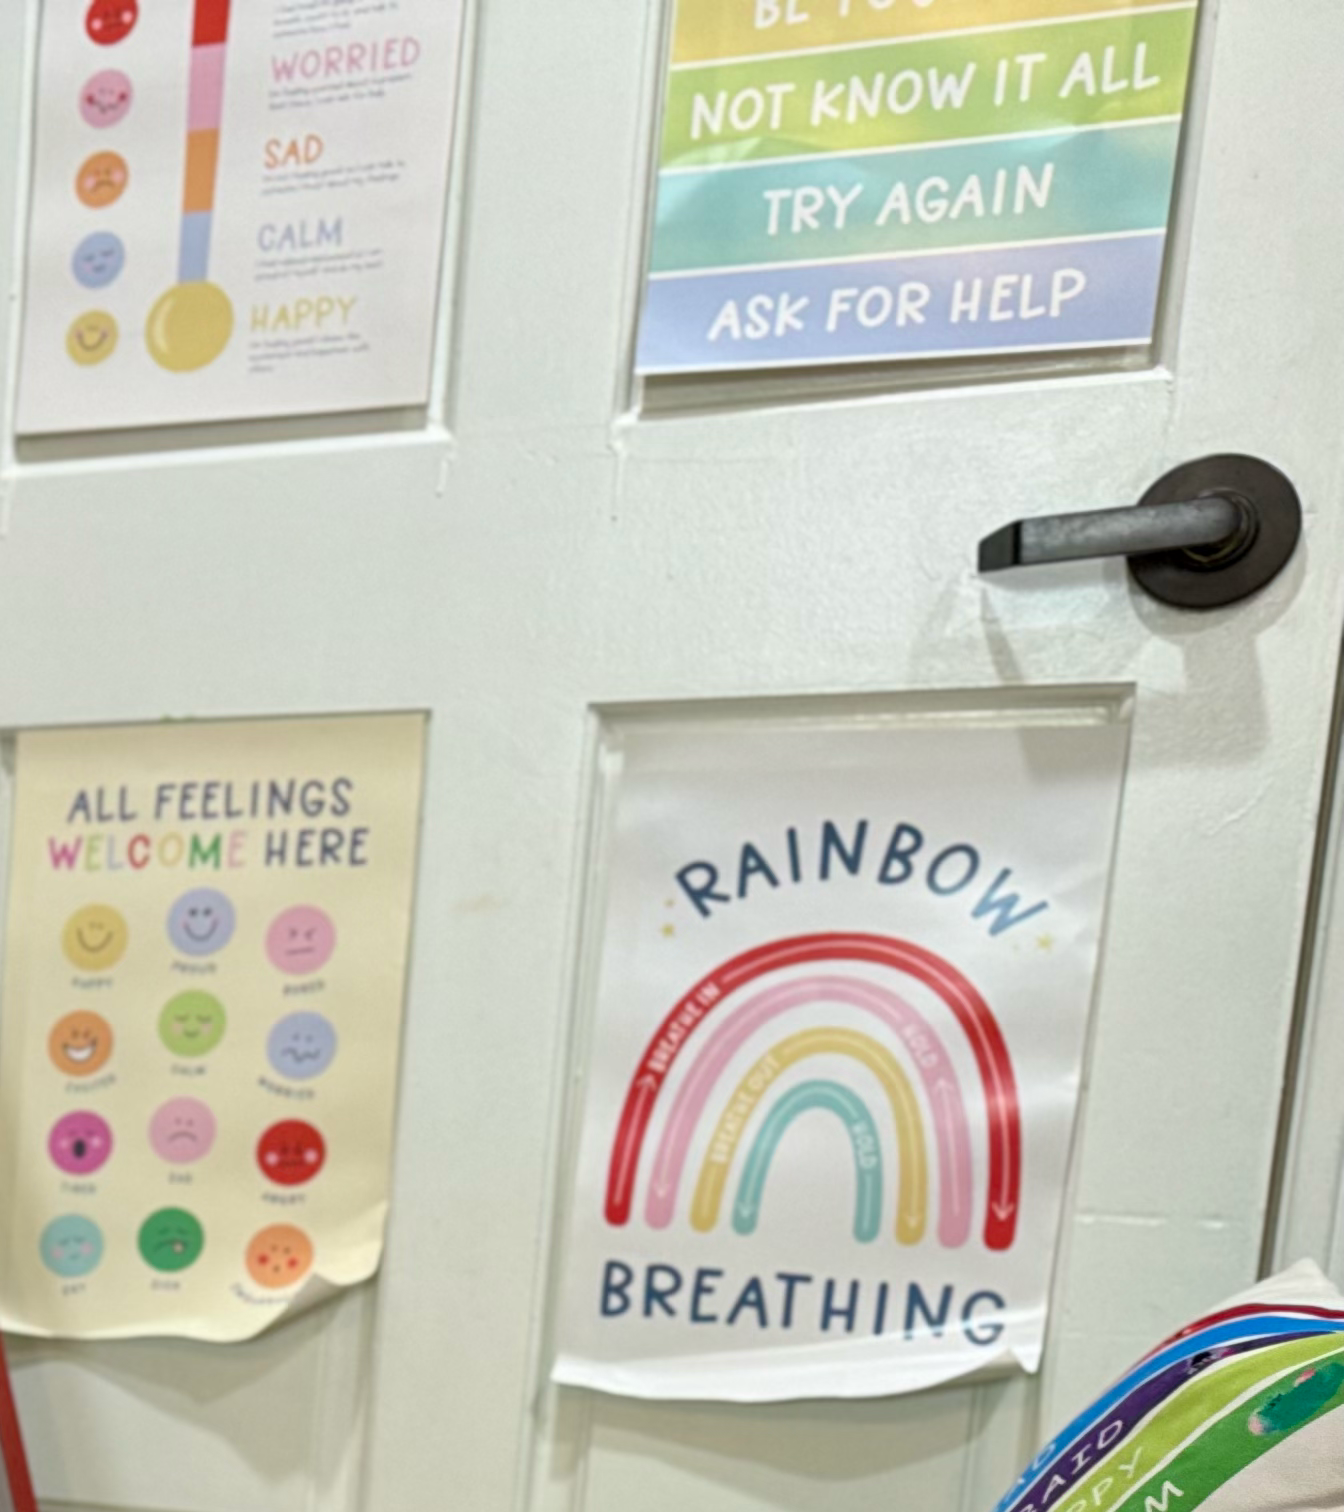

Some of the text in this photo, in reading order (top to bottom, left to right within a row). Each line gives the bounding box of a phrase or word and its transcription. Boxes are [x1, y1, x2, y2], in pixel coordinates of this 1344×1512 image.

[270, 36, 422, 83] WORRIED
[690, 42, 1161, 140] NOT KNOW IT ALL
[264, 133, 324, 170] SAD
[763, 162, 1055, 235] TRY AGAIN
[257, 216, 343, 251] CALM
[250, 294, 358, 332] HAPPY
[707, 268, 1087, 341] ASK FOR HELP
[67, 777, 353, 824] ALL FEELINGS
[48, 827, 369, 871] WELCOME HERE
[674, 819, 1049, 937] RAINBOW
[647, 984, 721, 1074] BREATHE IN
[902, 1026, 939, 1068] HOLD
[600, 1260, 1006, 1345] BREATHING
